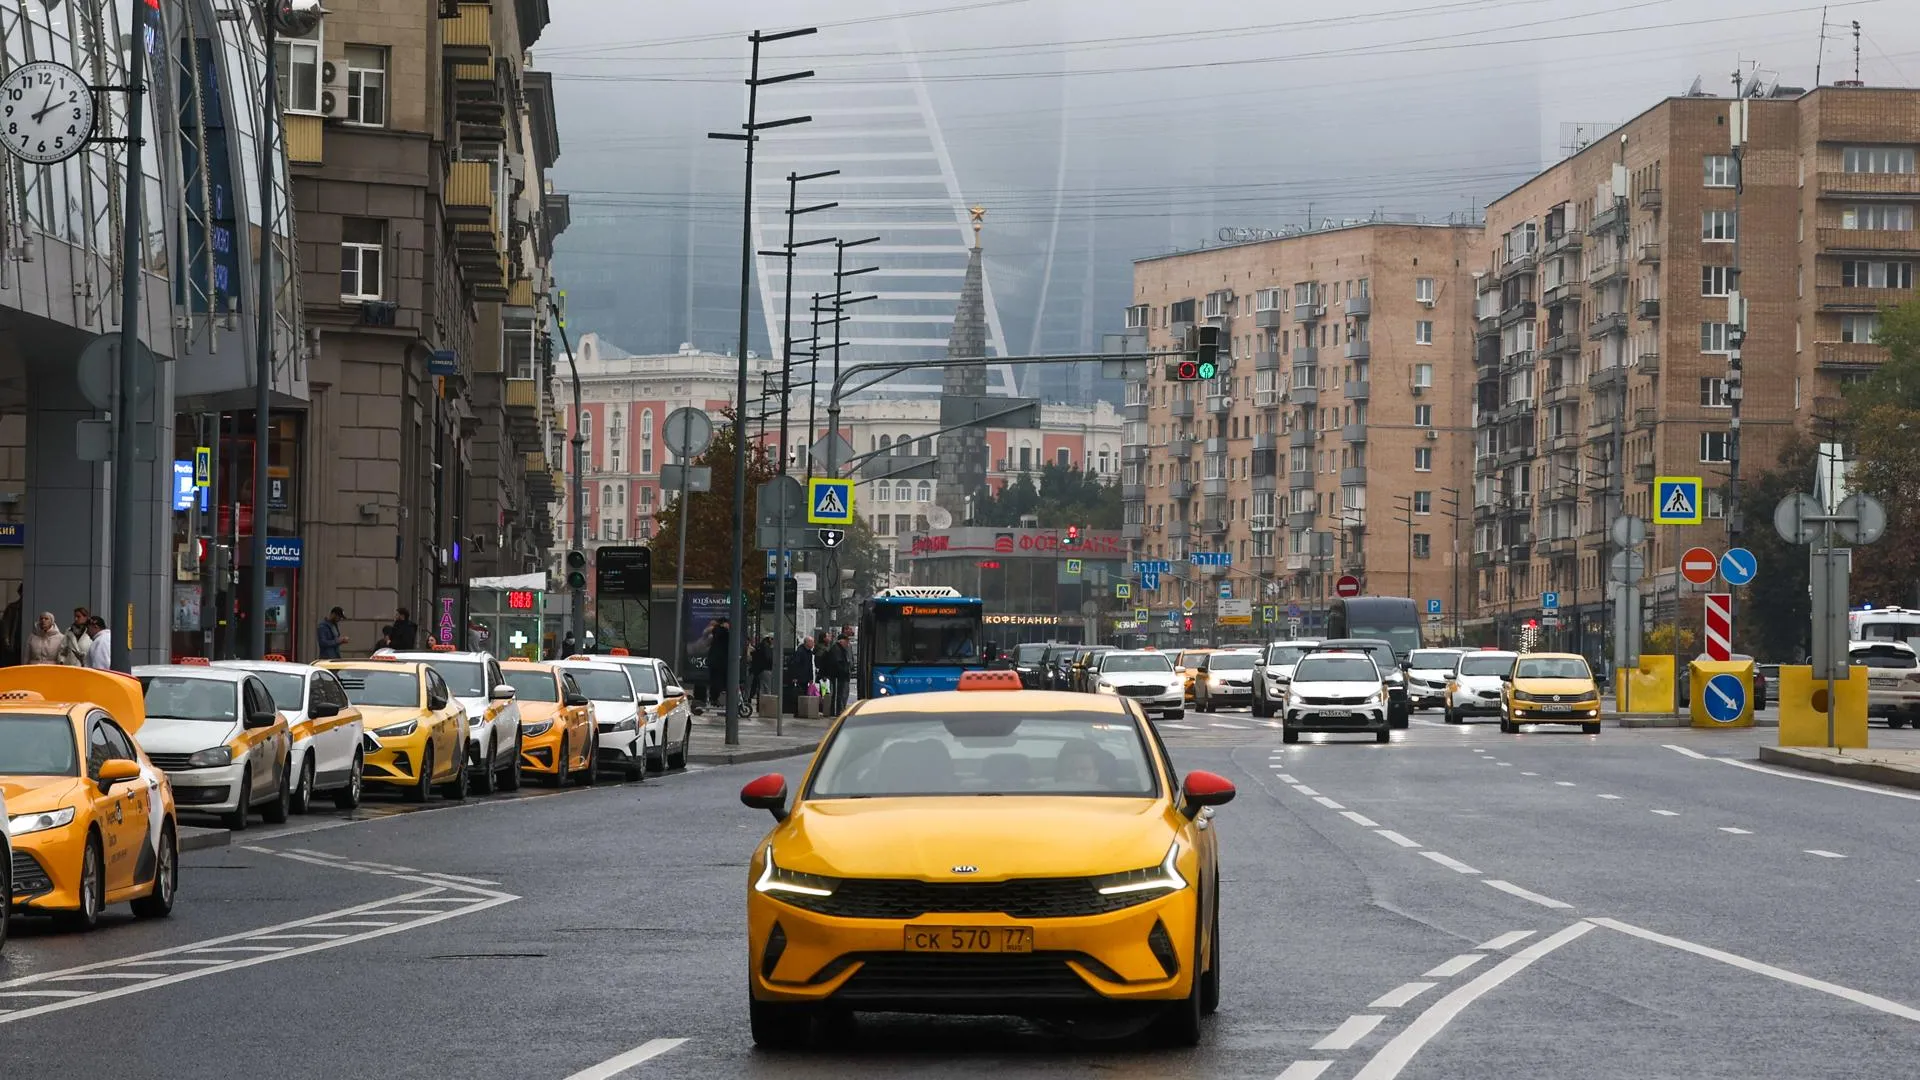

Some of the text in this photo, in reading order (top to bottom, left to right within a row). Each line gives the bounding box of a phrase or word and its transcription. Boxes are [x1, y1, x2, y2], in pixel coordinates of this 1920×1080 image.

[21, 76, 33, 89] 11
[38, 73, 52, 85] 12
[60, 77, 65, 90] 1
[8, 88, 23, 101] 10
[68, 90, 78, 103] 2
[5, 105, 14, 118] 9
[72, 107, 82, 120] 3
[8, 122, 18, 135] 8
[66, 124, 77, 137] 4
[21, 135, 30, 148] 7
[37, 140, 46, 153] 6
[54, 136, 63, 149] 5
[265, 544, 300, 556] dant.ru
[440, 598, 455, 646] ТАБ
[985, 615, 1059, 625] КОФЕМАНИЯ
[951, 929, 991, 949] 570
[1004, 929, 1025, 944] 77
